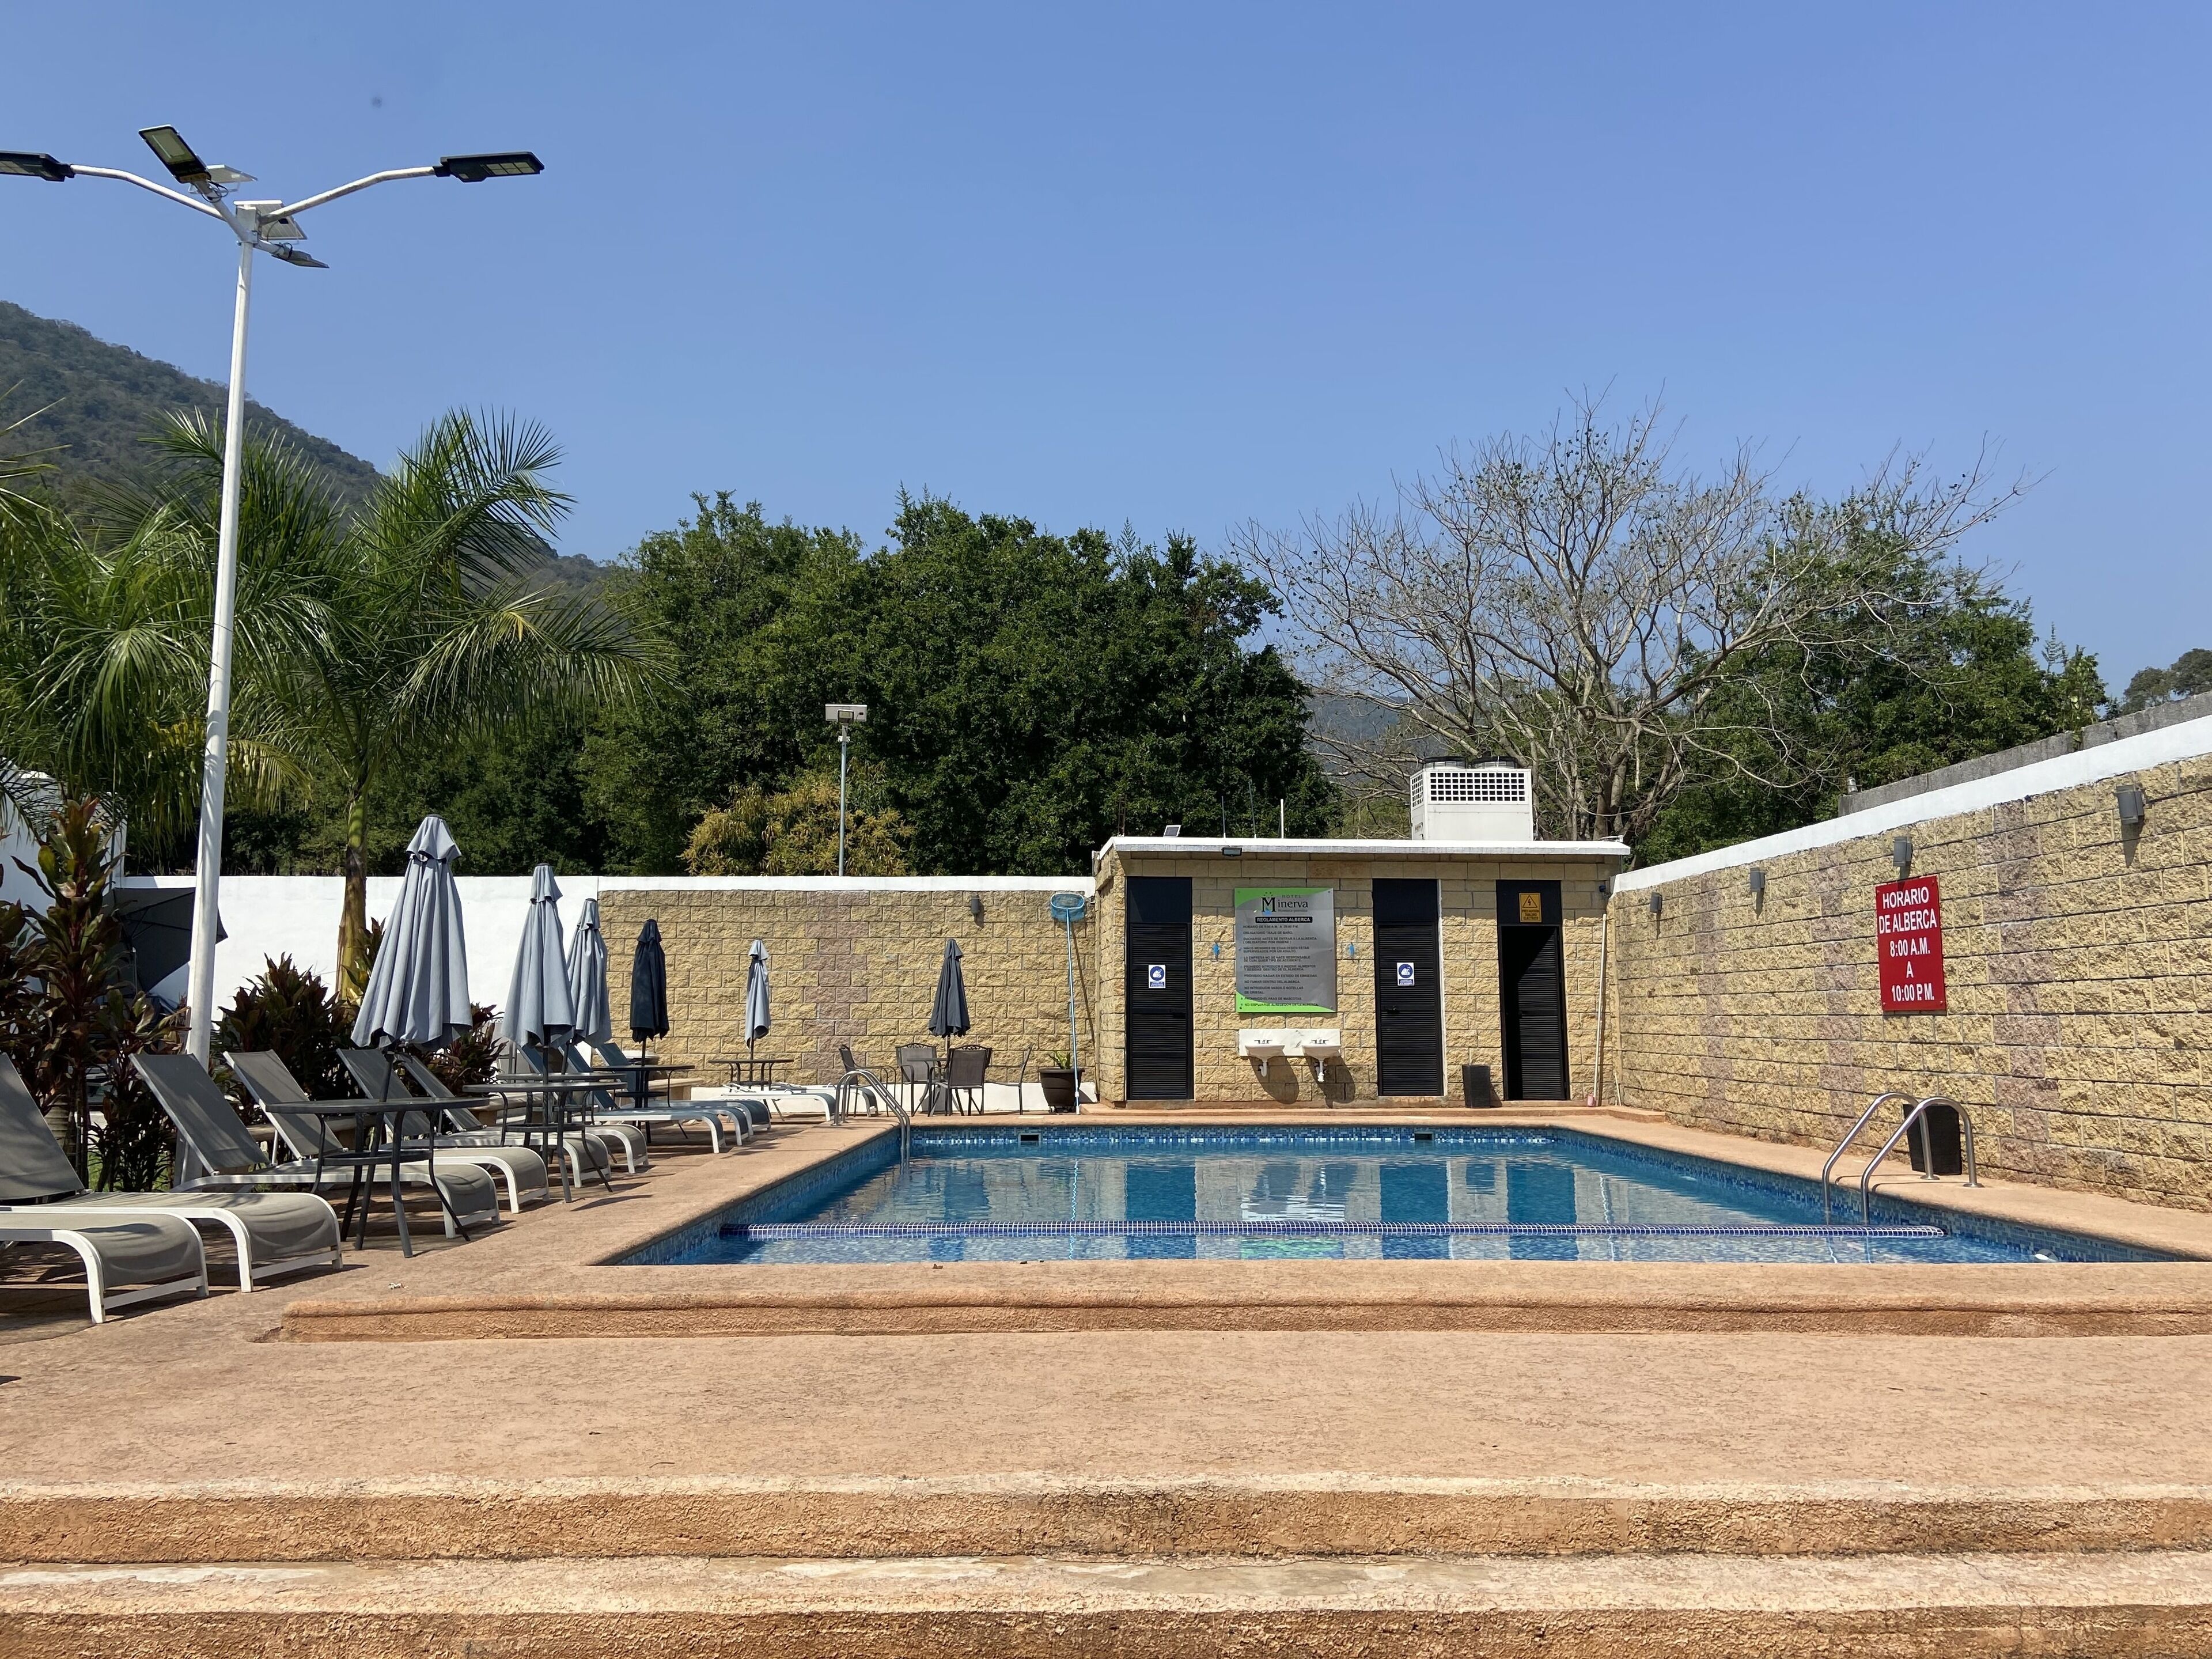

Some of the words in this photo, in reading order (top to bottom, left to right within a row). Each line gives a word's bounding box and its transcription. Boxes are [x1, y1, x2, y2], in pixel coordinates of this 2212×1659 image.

[1262, 897, 1308, 912] Minerva
[1883, 887, 1929, 909] HORARIO
[1878, 914, 1891, 934] DE
[1892, 908, 1937, 932] ALBERCA
[1890, 939, 1908, 957] 8:00
[1910, 937, 1930, 956] A.M.
[1906, 961, 1914, 978] A
[1892, 984, 1915, 1001] 10:00
